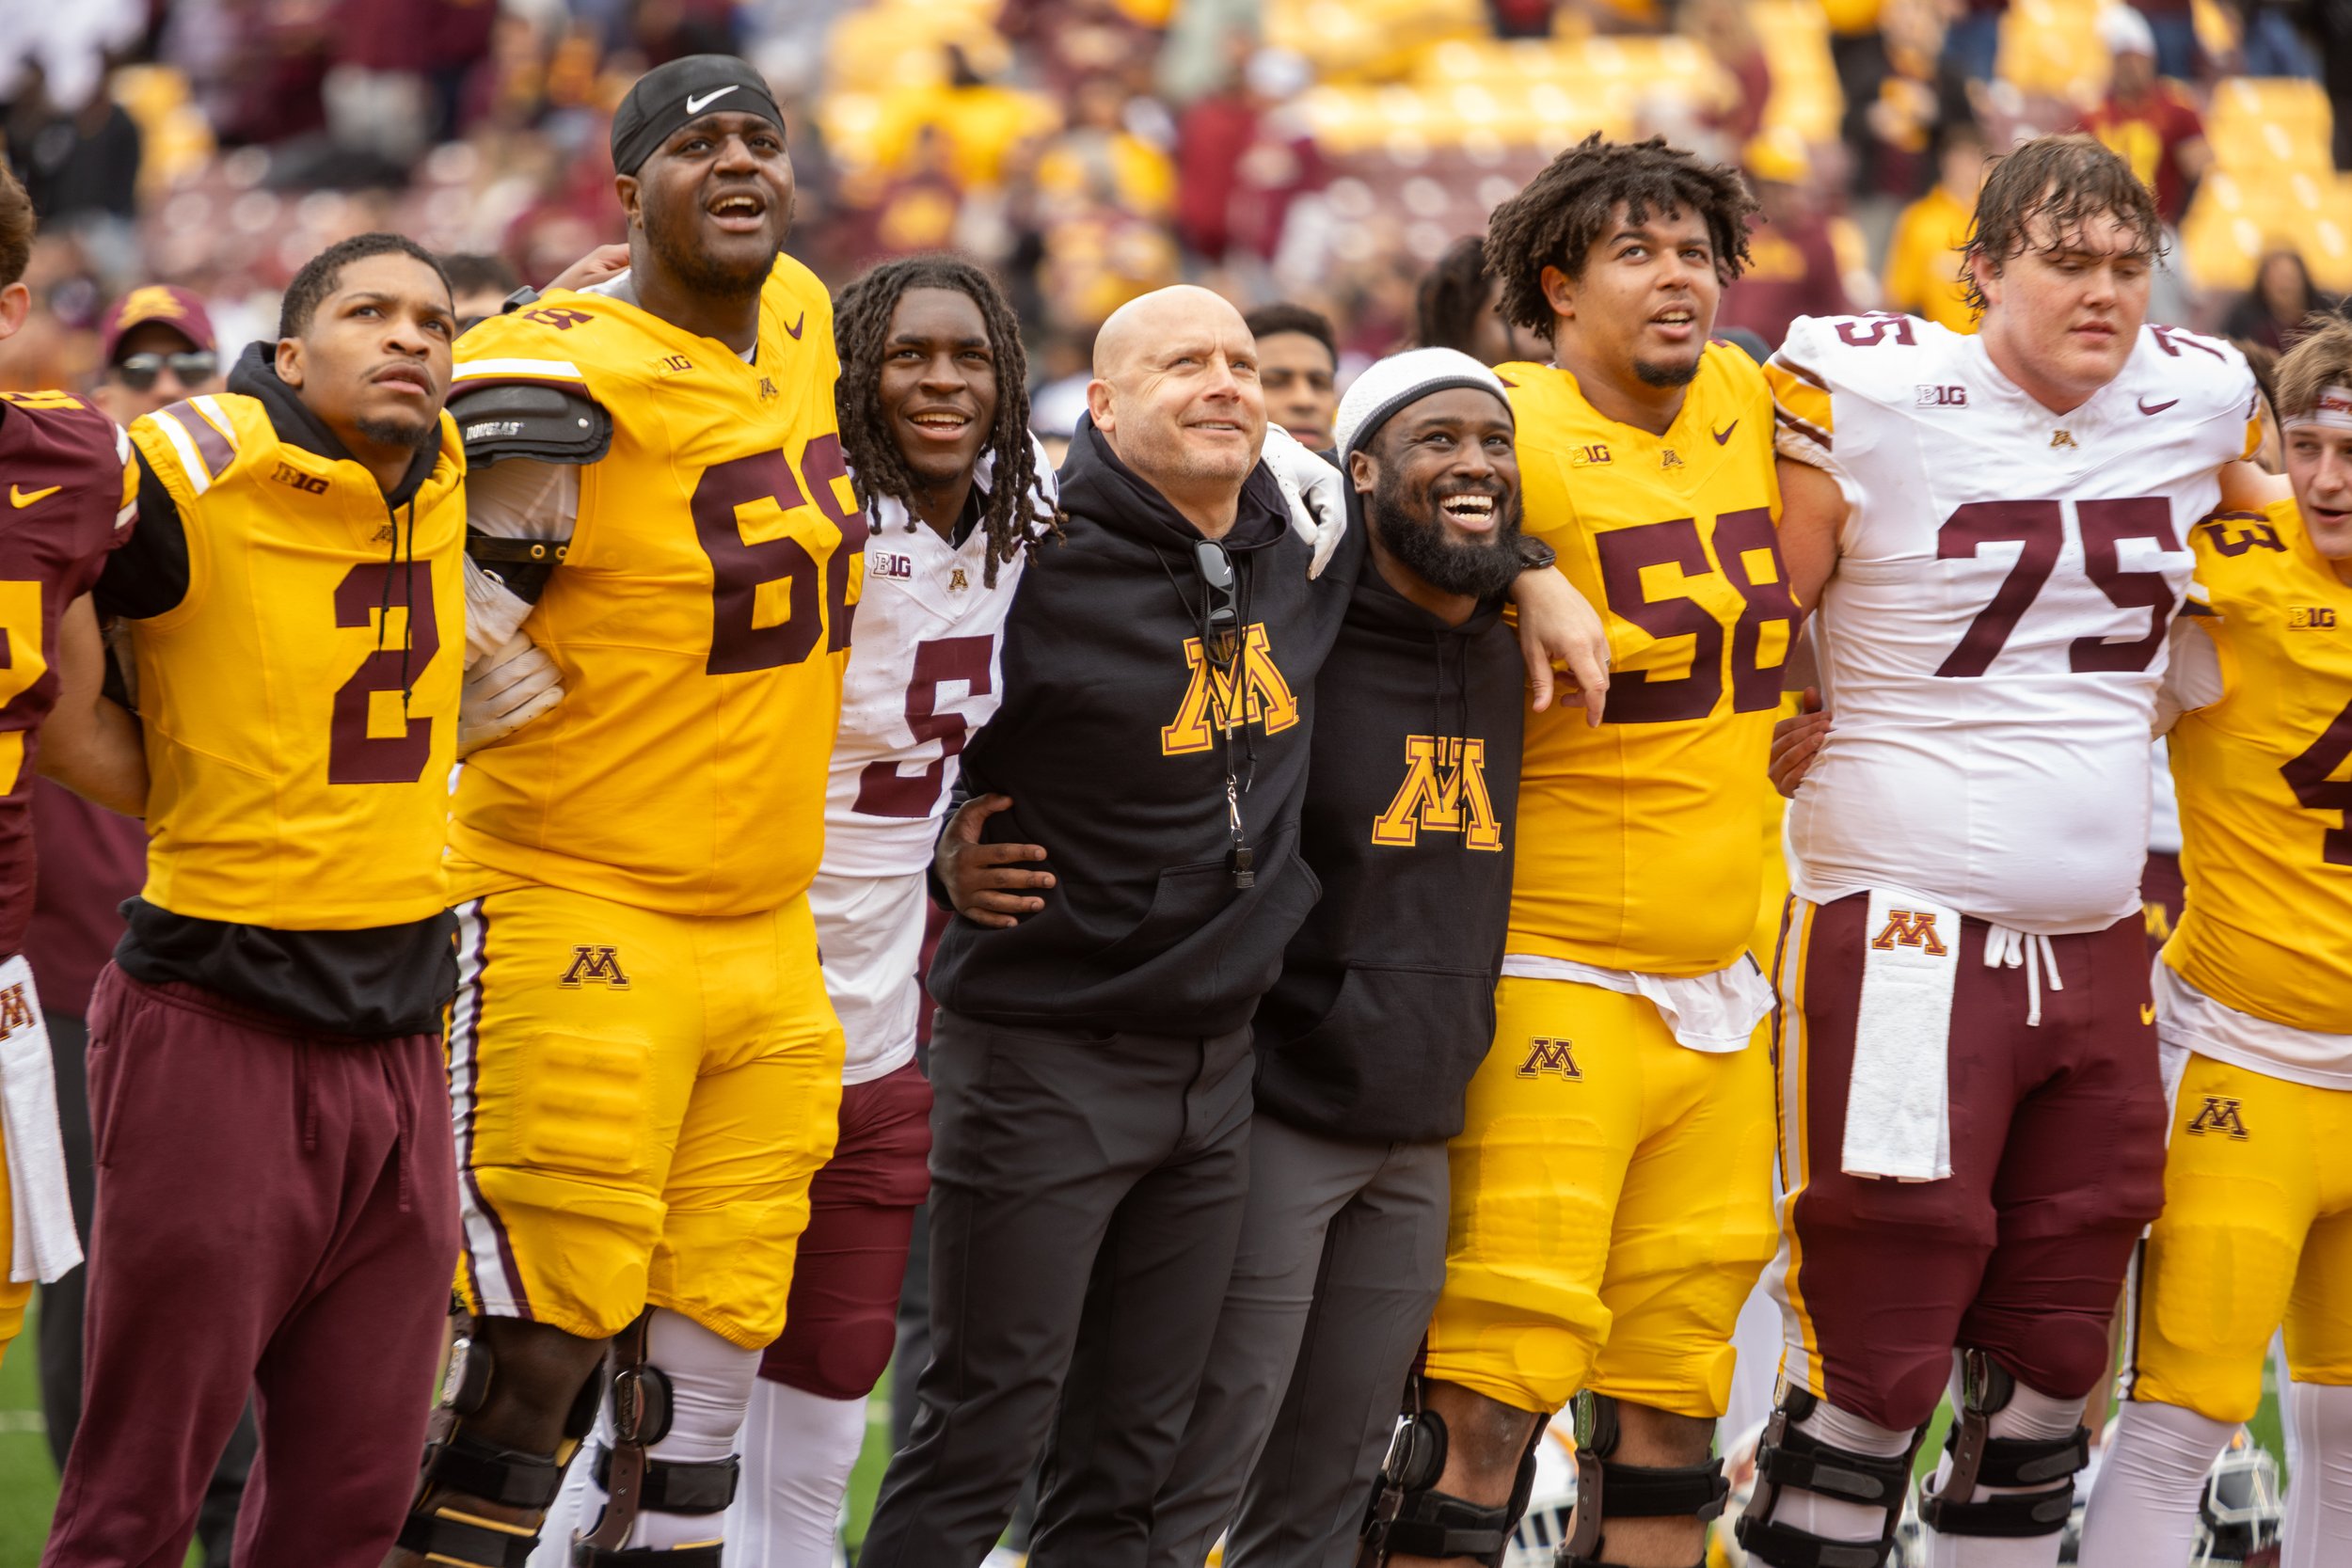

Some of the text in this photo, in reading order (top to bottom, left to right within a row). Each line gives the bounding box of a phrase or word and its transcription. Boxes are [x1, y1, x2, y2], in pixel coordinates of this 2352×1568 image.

[1595, 506, 1803, 723] 58
[1934, 497, 2183, 677] 75
[328, 560, 439, 784] 2
[851, 634, 994, 817] 5
[1162, 623, 1298, 755] M
[1372, 735, 1502, 850] M
[559, 944, 630, 988] M
[1871, 910, 1947, 957] M
[1517, 1037, 1583, 1081] M
[2187, 1096, 2249, 1139] M
